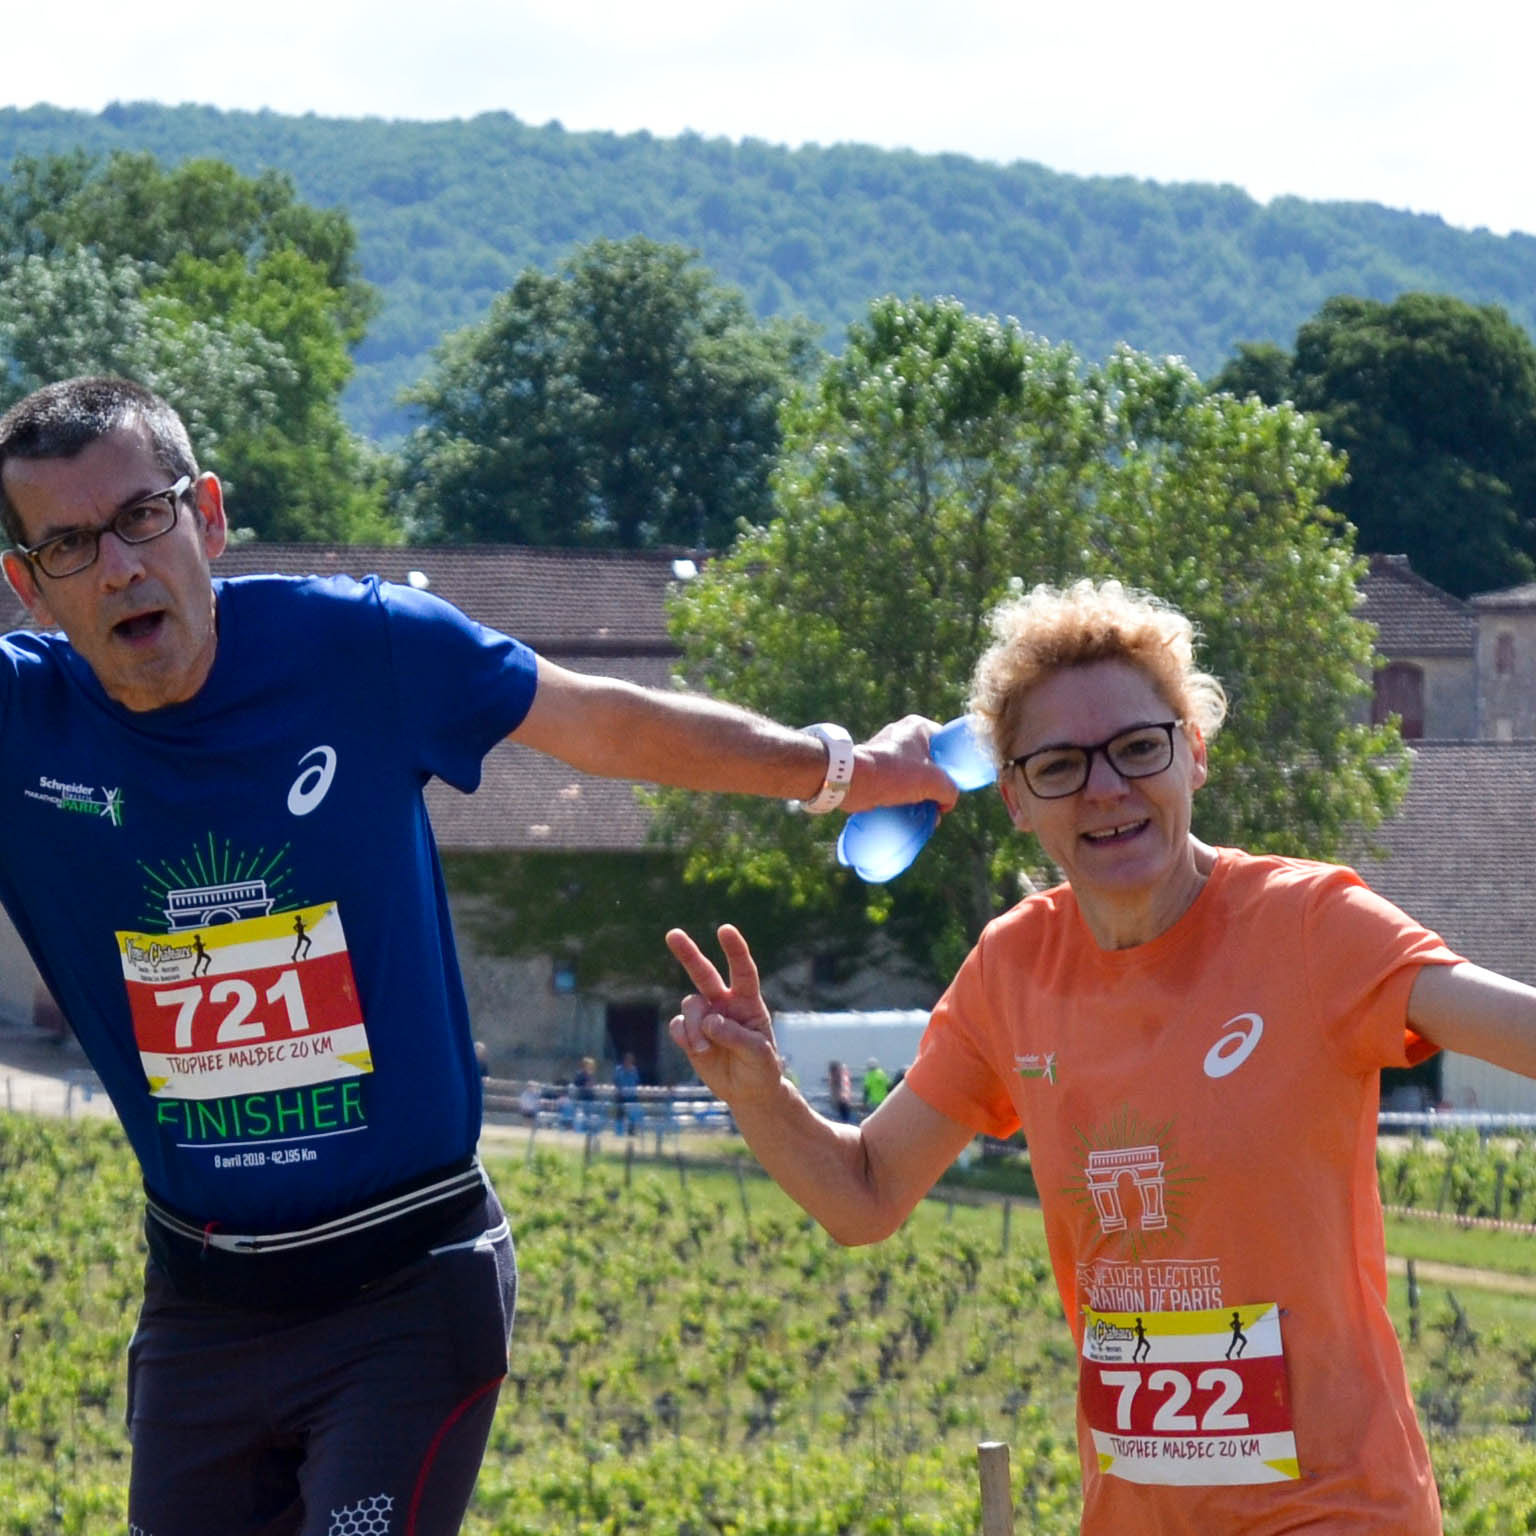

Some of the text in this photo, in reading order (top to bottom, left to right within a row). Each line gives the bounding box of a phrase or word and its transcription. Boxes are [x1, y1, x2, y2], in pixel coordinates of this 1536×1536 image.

[40, 776, 94, 795] Schneider
[64, 799, 100, 814] PARIS
[154, 969, 310, 1048] 721
[166, 1036, 333, 1074] TROPHEE MALBEC 20 KM
[157, 1082, 365, 1139] FINISHER
[214, 1155, 221, 1168] 8
[222, 1154, 241, 1168] avril
[243, 1152, 265, 1167] 2018
[302, 1148, 317, 1161] Km
[1147, 1265, 1221, 1287] ELECTRIC
[1150, 1288, 1165, 1312] DE
[1170, 1287, 1224, 1312] PARIS
[1099, 1368, 1250, 1431] 722
[1110, 1437, 1261, 1459] TROPHEE MALBEC 20 KM
